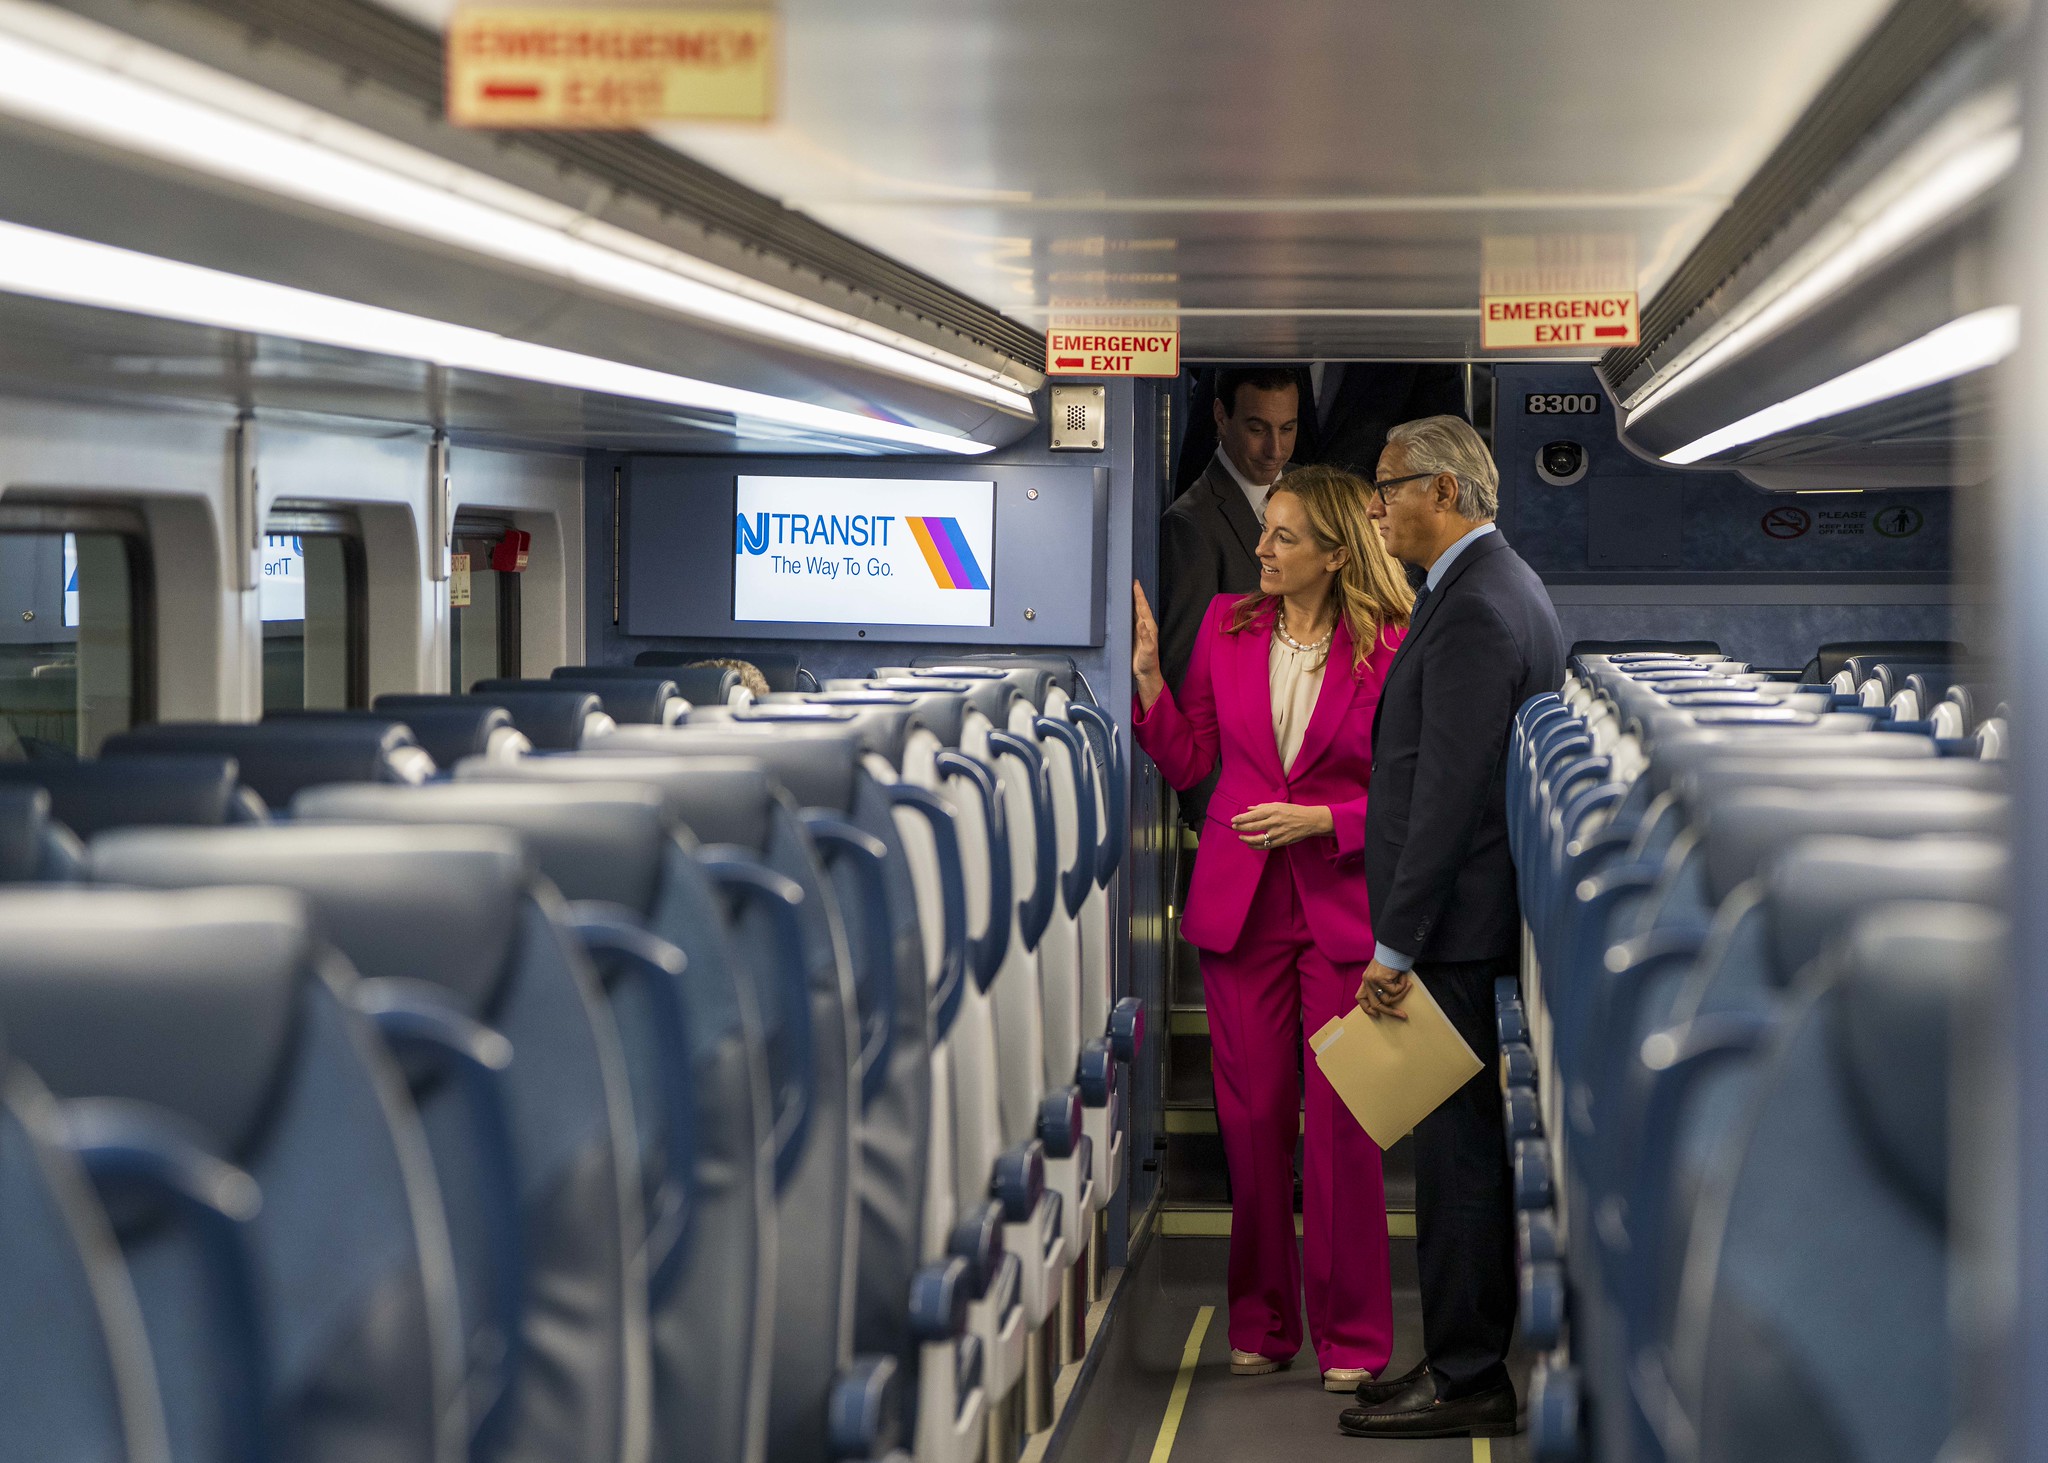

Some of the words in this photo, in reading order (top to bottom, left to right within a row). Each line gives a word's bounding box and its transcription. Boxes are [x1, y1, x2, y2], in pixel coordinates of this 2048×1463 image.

[1489, 299, 1630, 321] EMERGENCY
[1535, 323, 1584, 342] EXIT
[1052, 335, 1172, 353] EMERGENCY
[1091, 356, 1134, 371] EXIT
[1529, 394, 1597, 413] 8300
[1818, 511, 1867, 519] PLEASE
[772, 513, 895, 546] TRANSIT
[771, 556, 801, 574] The
[806, 556, 840, 579] Way
[843, 557, 861, 575] To
[867, 557, 894, 576] Go.
